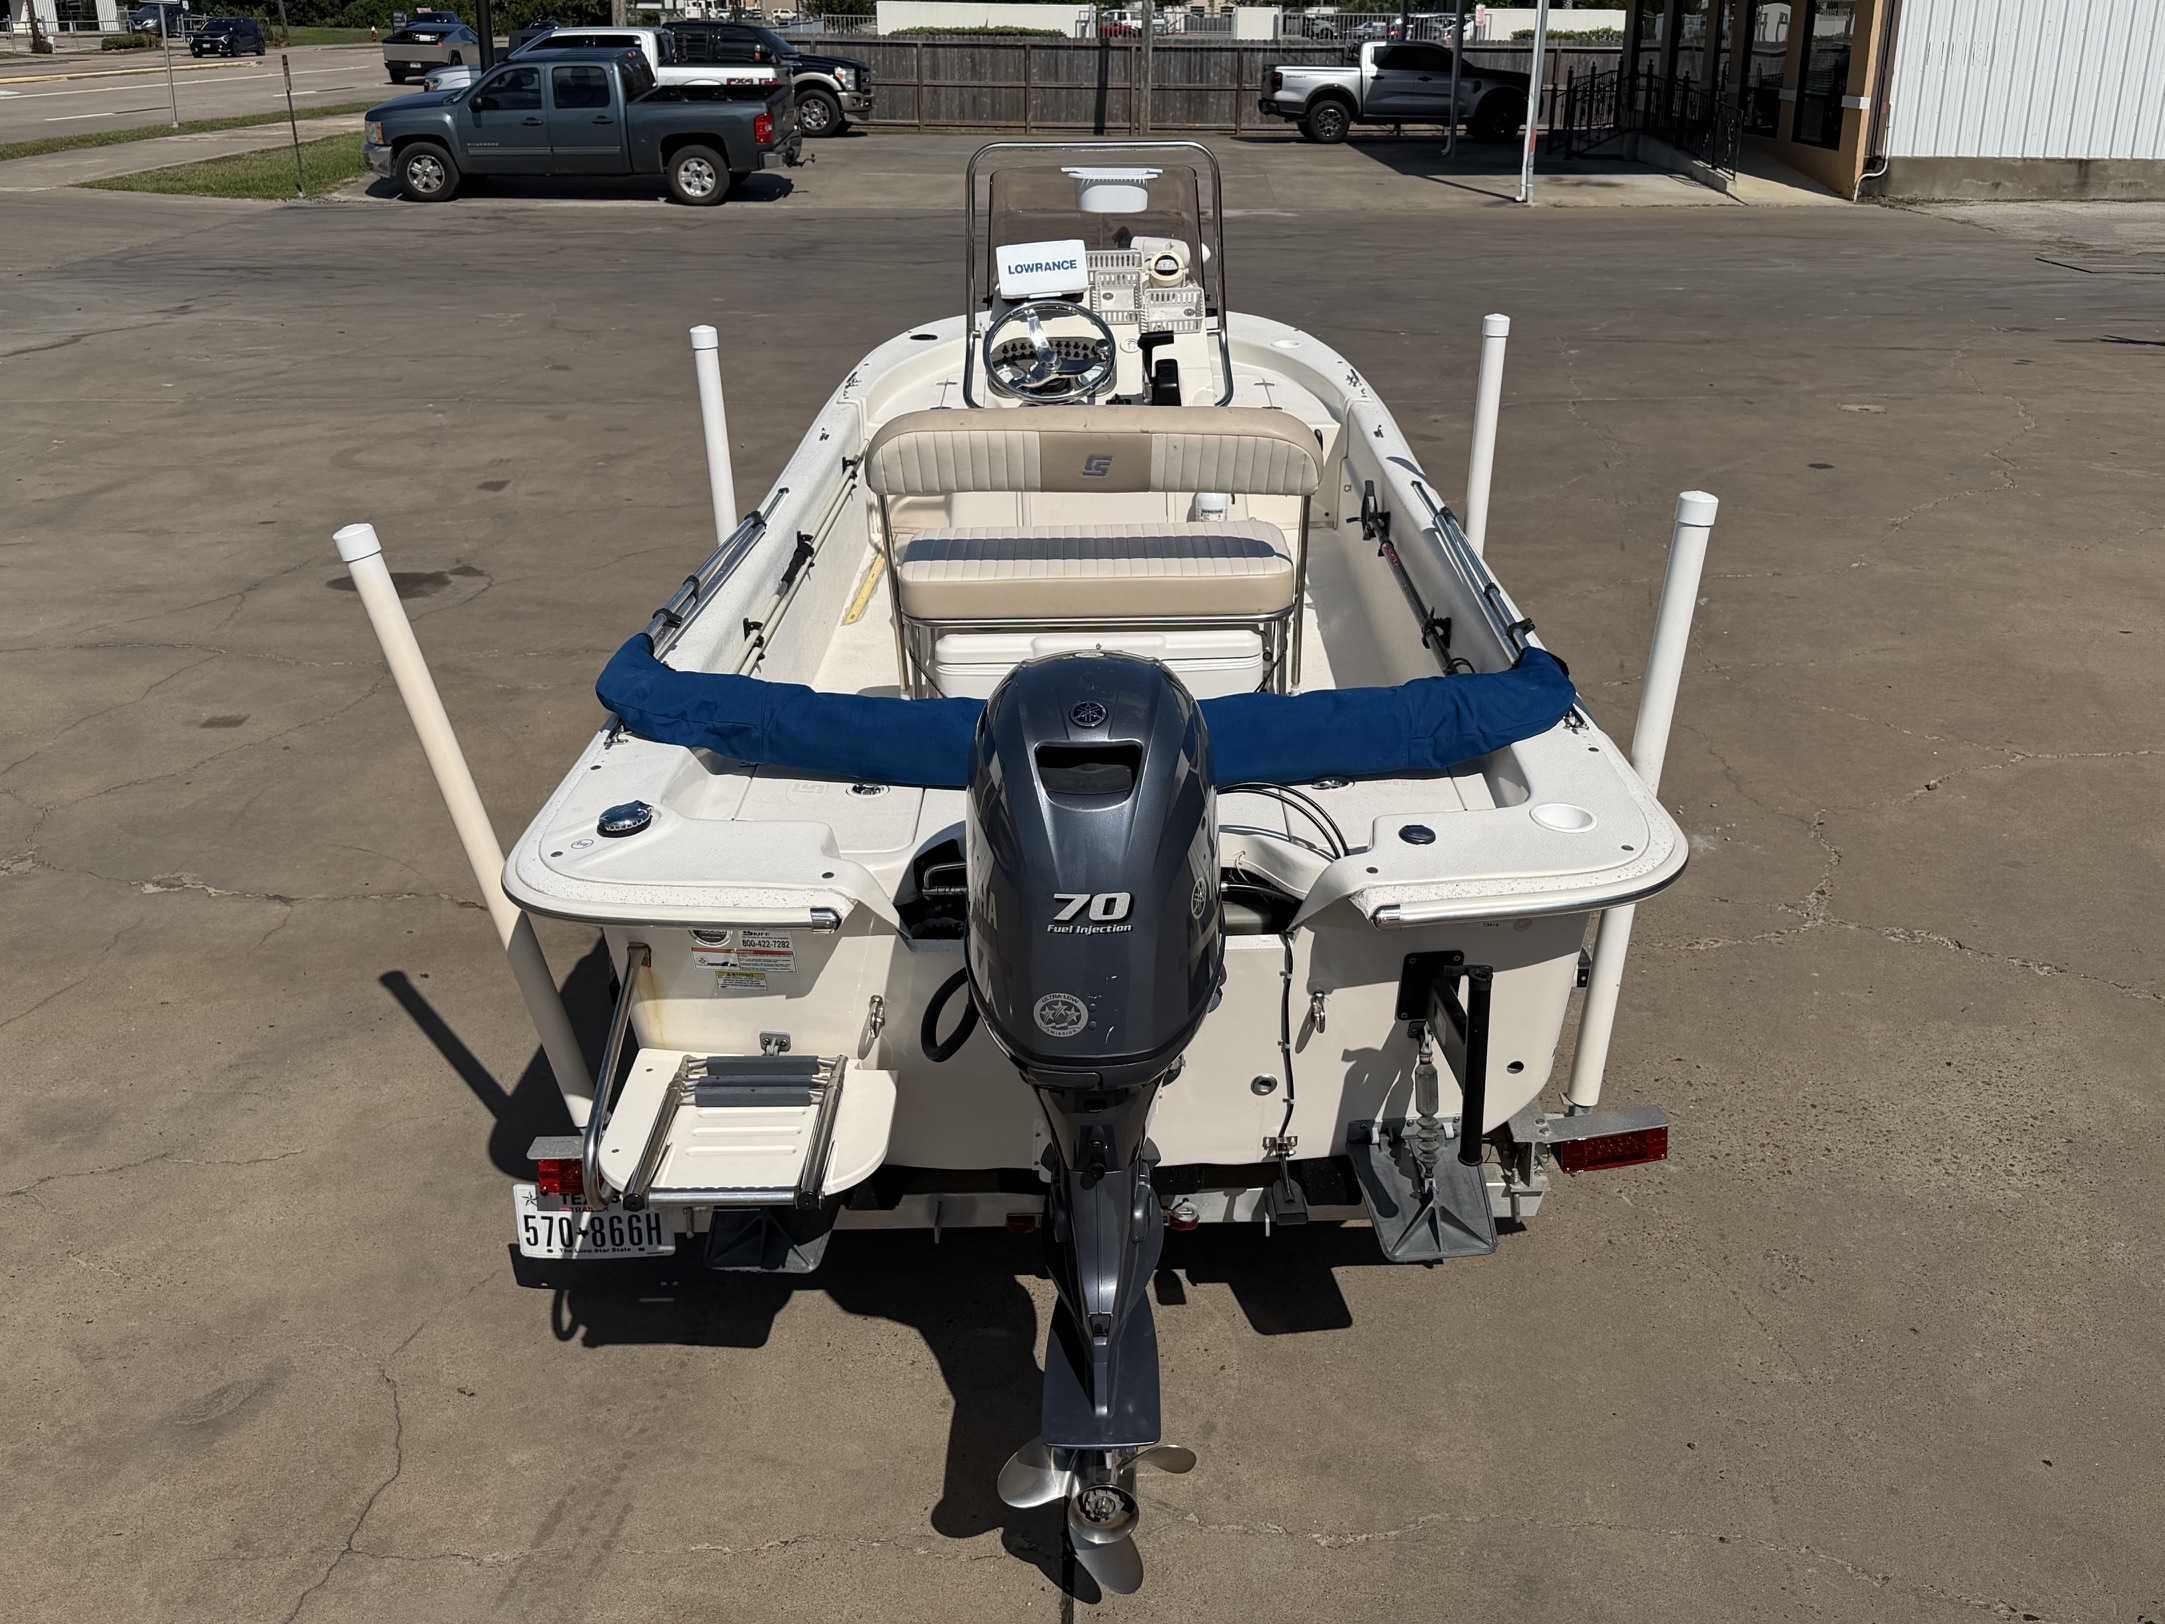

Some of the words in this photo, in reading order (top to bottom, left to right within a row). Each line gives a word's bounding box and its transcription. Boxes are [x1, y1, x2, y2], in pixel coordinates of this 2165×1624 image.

[1008, 259, 1077, 274] LOWRANCE
[1053, 892, 1131, 921] 70
[1047, 924, 1073, 933] Fuel
[1076, 924, 1132, 935] Injection
[742, 939, 790, 948] 800-422-7282
[523, 1214, 573, 1247] 570
[591, 1213, 662, 1247] 866H
